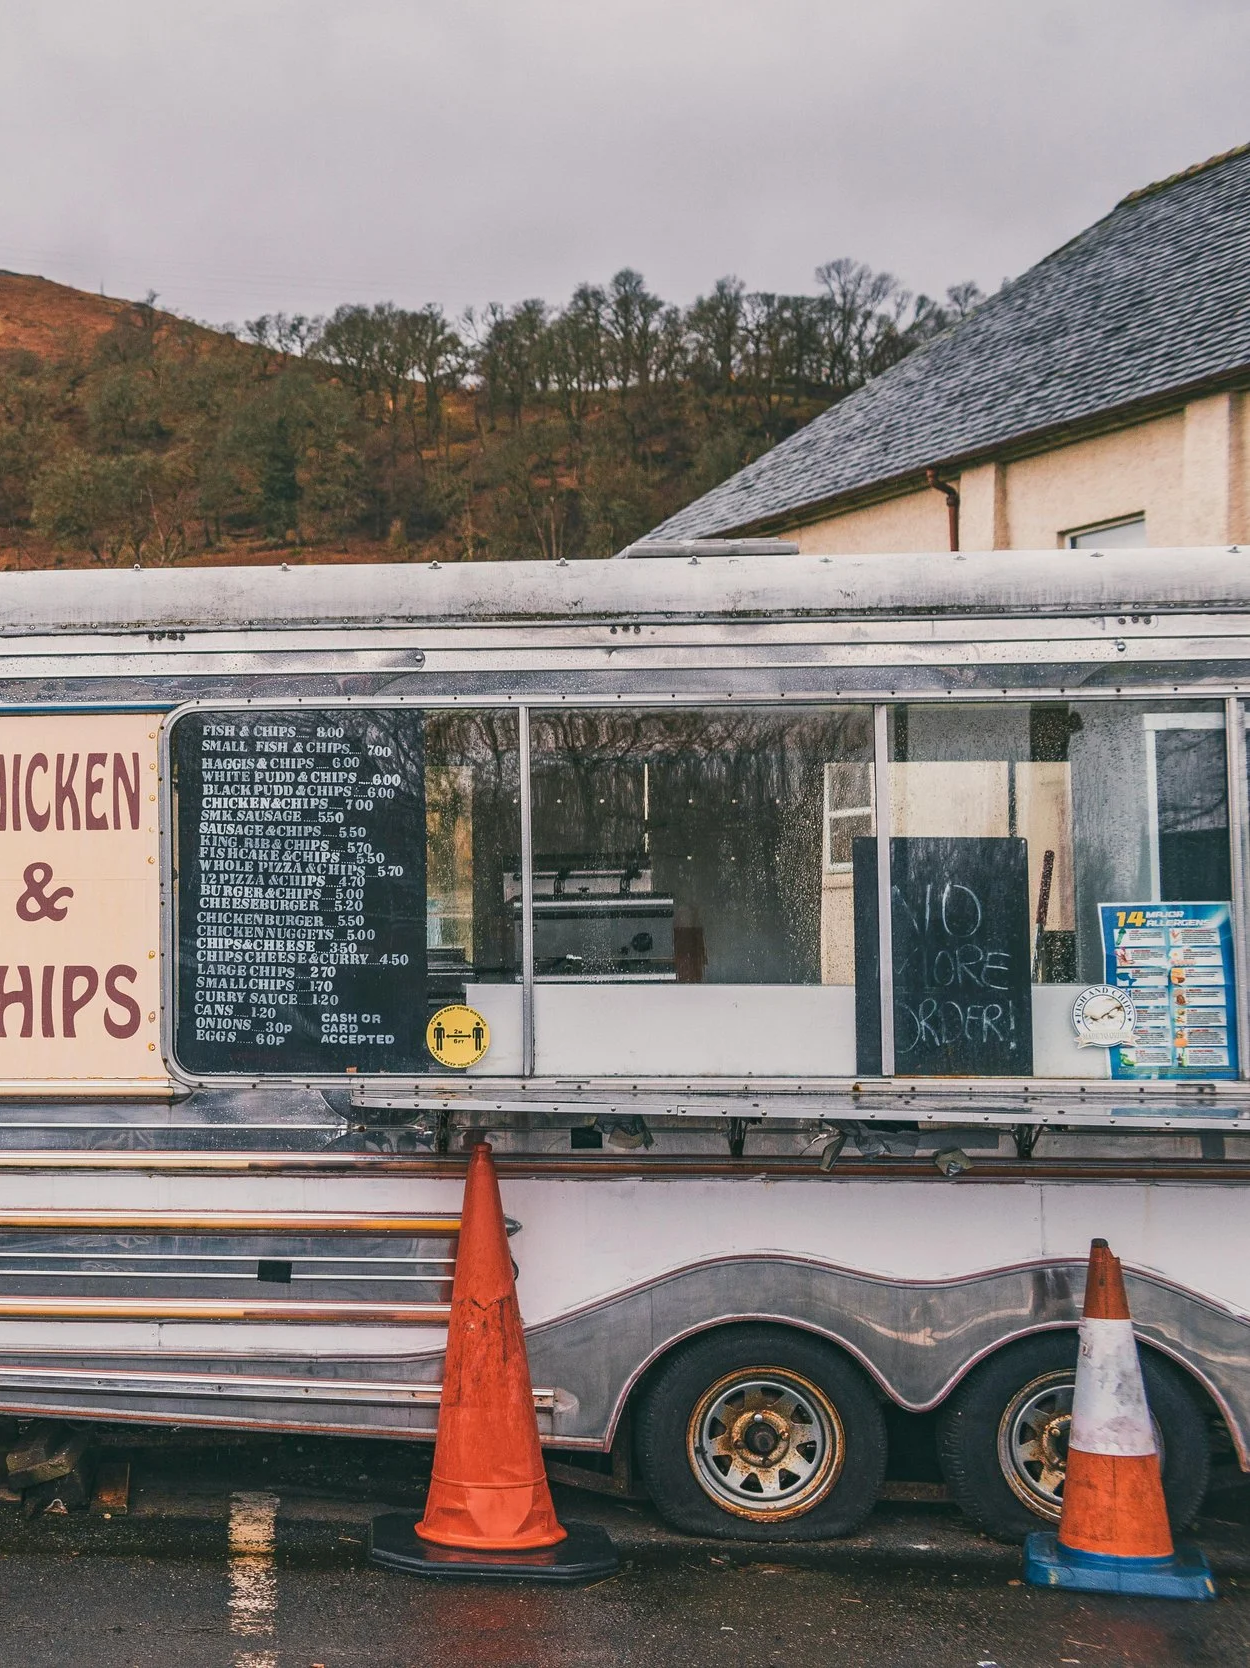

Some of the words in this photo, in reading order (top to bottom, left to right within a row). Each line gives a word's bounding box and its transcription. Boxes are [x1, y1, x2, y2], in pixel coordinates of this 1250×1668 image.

[202, 725, 236, 737] FISH
[239, 725, 250, 738] &
[253, 725, 297, 738] CHIPS
[316, 726, 345, 738] 8.00
[201, 739, 248, 752] SMALL
[255, 741, 289, 753] FISH
[292, 741, 304, 754] &
[306, 742, 351, 755] CHIPS
[201, 757, 255, 770] HAGGIS
[256, 757, 268, 770] &
[269, 757, 315, 769] CHIPS
[332, 756, 360, 769] 6.00
[201, 770, 251, 782] WHITE
[254, 771, 296, 783] PUDD
[297, 771, 308, 783] &
[310, 771, 358, 784] CHIPS
[372, 773, 401, 787] 6.00
[202, 784, 251, 796] BLACK
[253, 784, 294, 796] PUDD
[367, 786, 395, 799] 6.00
[317, 811, 345, 824] 5.50
[198, 822, 264, 836] SAUSAGE
[338, 826, 367, 838] 5.50
[244, 837, 271, 849] RIB
[347, 841, 372, 855] 5.70
[198, 847, 280, 861] FISHCAKE
[356, 852, 385, 865] 5.50
[198, 859, 254, 872] WHOLE
[257, 861, 303, 874] PIZZA
[377, 865, 404, 877] 5.70
[200, 873, 217, 885] 1/2
[219, 873, 265, 886] PIZZA
[338, 876, 366, 888] 4.70
[15, 861, 75, 922] &
[335, 888, 365, 900] 5.00
[199, 897, 319, 912] CHEESEBURGER
[334, 899, 364, 912] 5.20
[891, 880, 982, 938] NO
[337, 914, 365, 927] 5.50
[1116, 911, 1147, 928] 14
[1146, 919, 1212, 927] ALLERGENS
[346, 929, 376, 941] 5.00
[379, 953, 409, 966] 4.50
[197, 963, 247, 976] LARGE
[249, 965, 296, 978] CHIPS
[194, 990, 247, 1003] CURRY
[249, 992, 298, 1005] SAUCE
[312, 993, 339, 1006] 1.20
[1075, 995, 1088, 1018] FISH
[1088, 987, 1109, 998] AND
[1111, 989, 1134, 1016] CHIPS
[194, 1003, 234, 1016] CANS
[251, 1006, 277, 1019] 1.20
[321, 1013, 358, 1023] CASH
[361, 1013, 382, 1024] OR
[430, 1011, 444, 1026] PLEASE
[443, 1006, 456, 1014] KEEP
[469, 1008, 488, 1028] DISTANCE
[195, 1017, 252, 1031] ONIONS
[321, 1024, 359, 1034] CARD
[195, 1029, 237, 1043] EGGS
[320, 1034, 395, 1045] ACCEPTED
[431, 1046, 444, 1064] PLEASE
[443, 1059, 457, 1067] KEEP
[470, 1044, 488, 1065] DISTANCE
